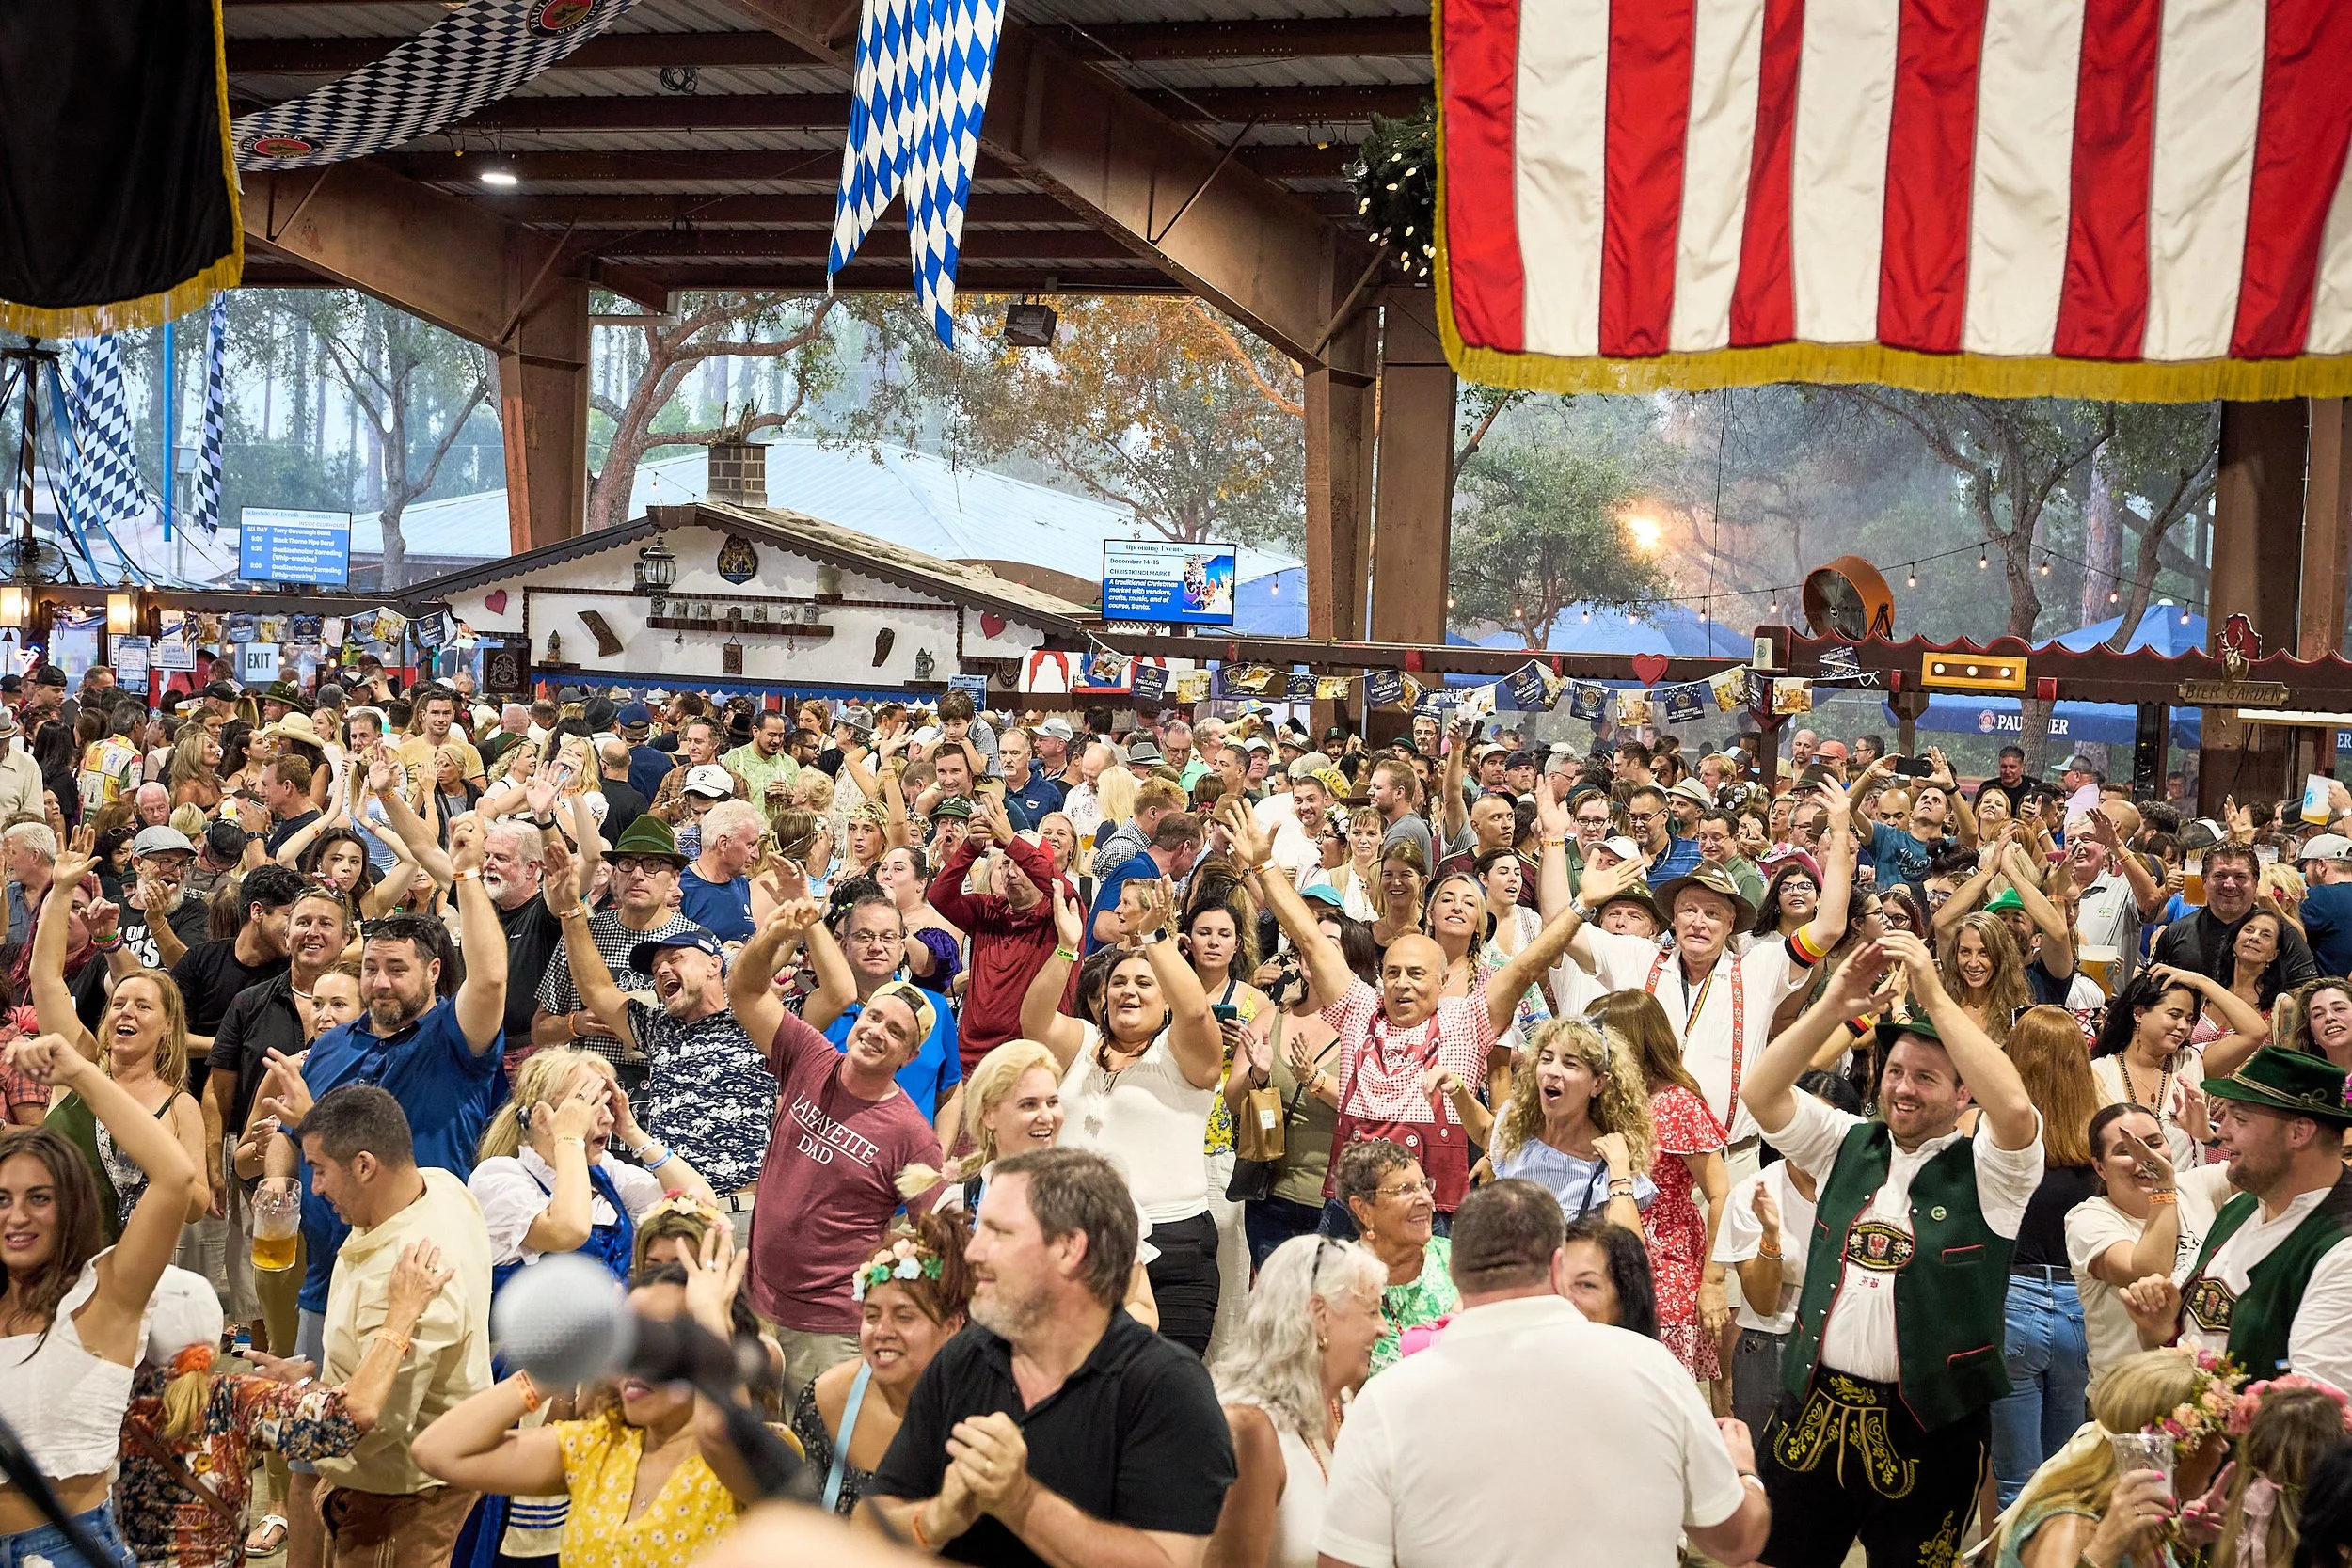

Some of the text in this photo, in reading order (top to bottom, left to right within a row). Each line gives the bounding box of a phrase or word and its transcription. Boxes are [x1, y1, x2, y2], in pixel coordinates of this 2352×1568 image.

[1126, 544, 1159, 553] Upcoming
[1109, 568, 1171, 577] CHRISTKINDLMARKT
[247, 653, 271, 669] EXIT
[1136, 678, 1163, 688] PAULANER
[1370, 681, 1399, 694] PAULANER
[1514, 679, 1540, 697] PAULANER
[2185, 685, 2281, 701] BIER GARDEN
[791, 1090, 880, 1164] LAFAYETTE
[796, 1133, 834, 1164] DAD
